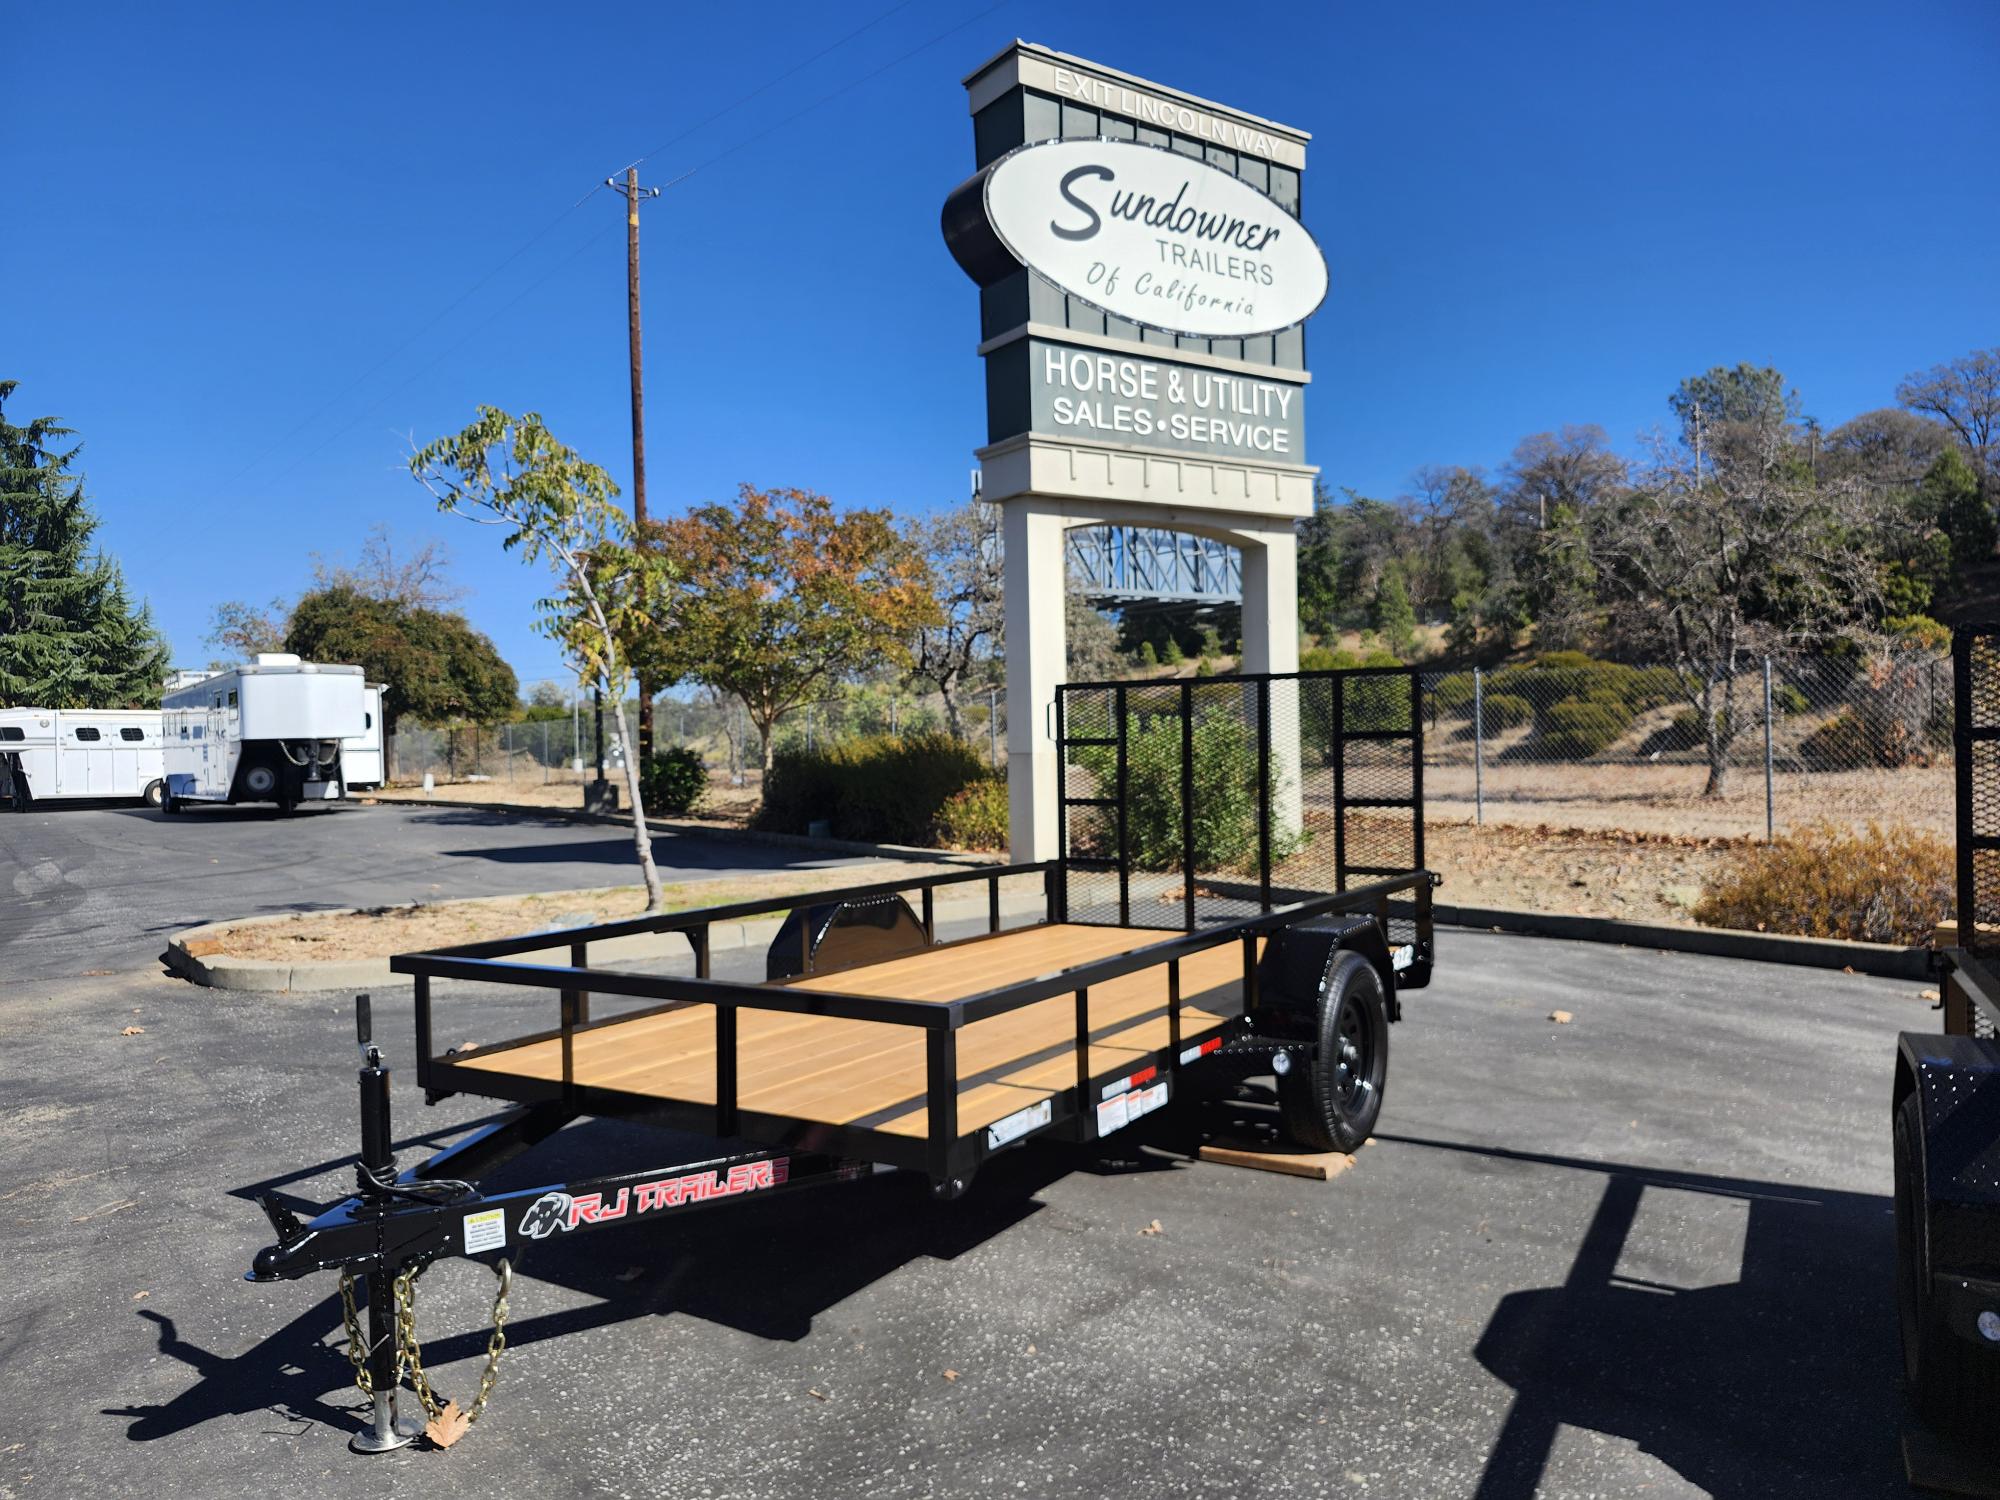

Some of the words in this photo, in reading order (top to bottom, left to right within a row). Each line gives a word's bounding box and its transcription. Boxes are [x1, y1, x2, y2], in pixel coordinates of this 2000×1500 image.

[1054, 67, 1114, 106] EXIT
[1121, 87, 1227, 143] LINCOLN
[1232, 125, 1281, 157] WAY
[1050, 164, 1280, 251] Sundowner
[1087, 262, 1120, 296] Of
[1135, 272, 1254, 316] California
[1155, 239, 1273, 286] TRAILERS
[1045, 348, 1158, 400] HORSE
[1167, 369, 1187, 404] &
[1192, 375, 1292, 420] UTILITY
[568, 1187, 630, 1227] RJ
[632, 1157, 790, 1214] TRAILERS
